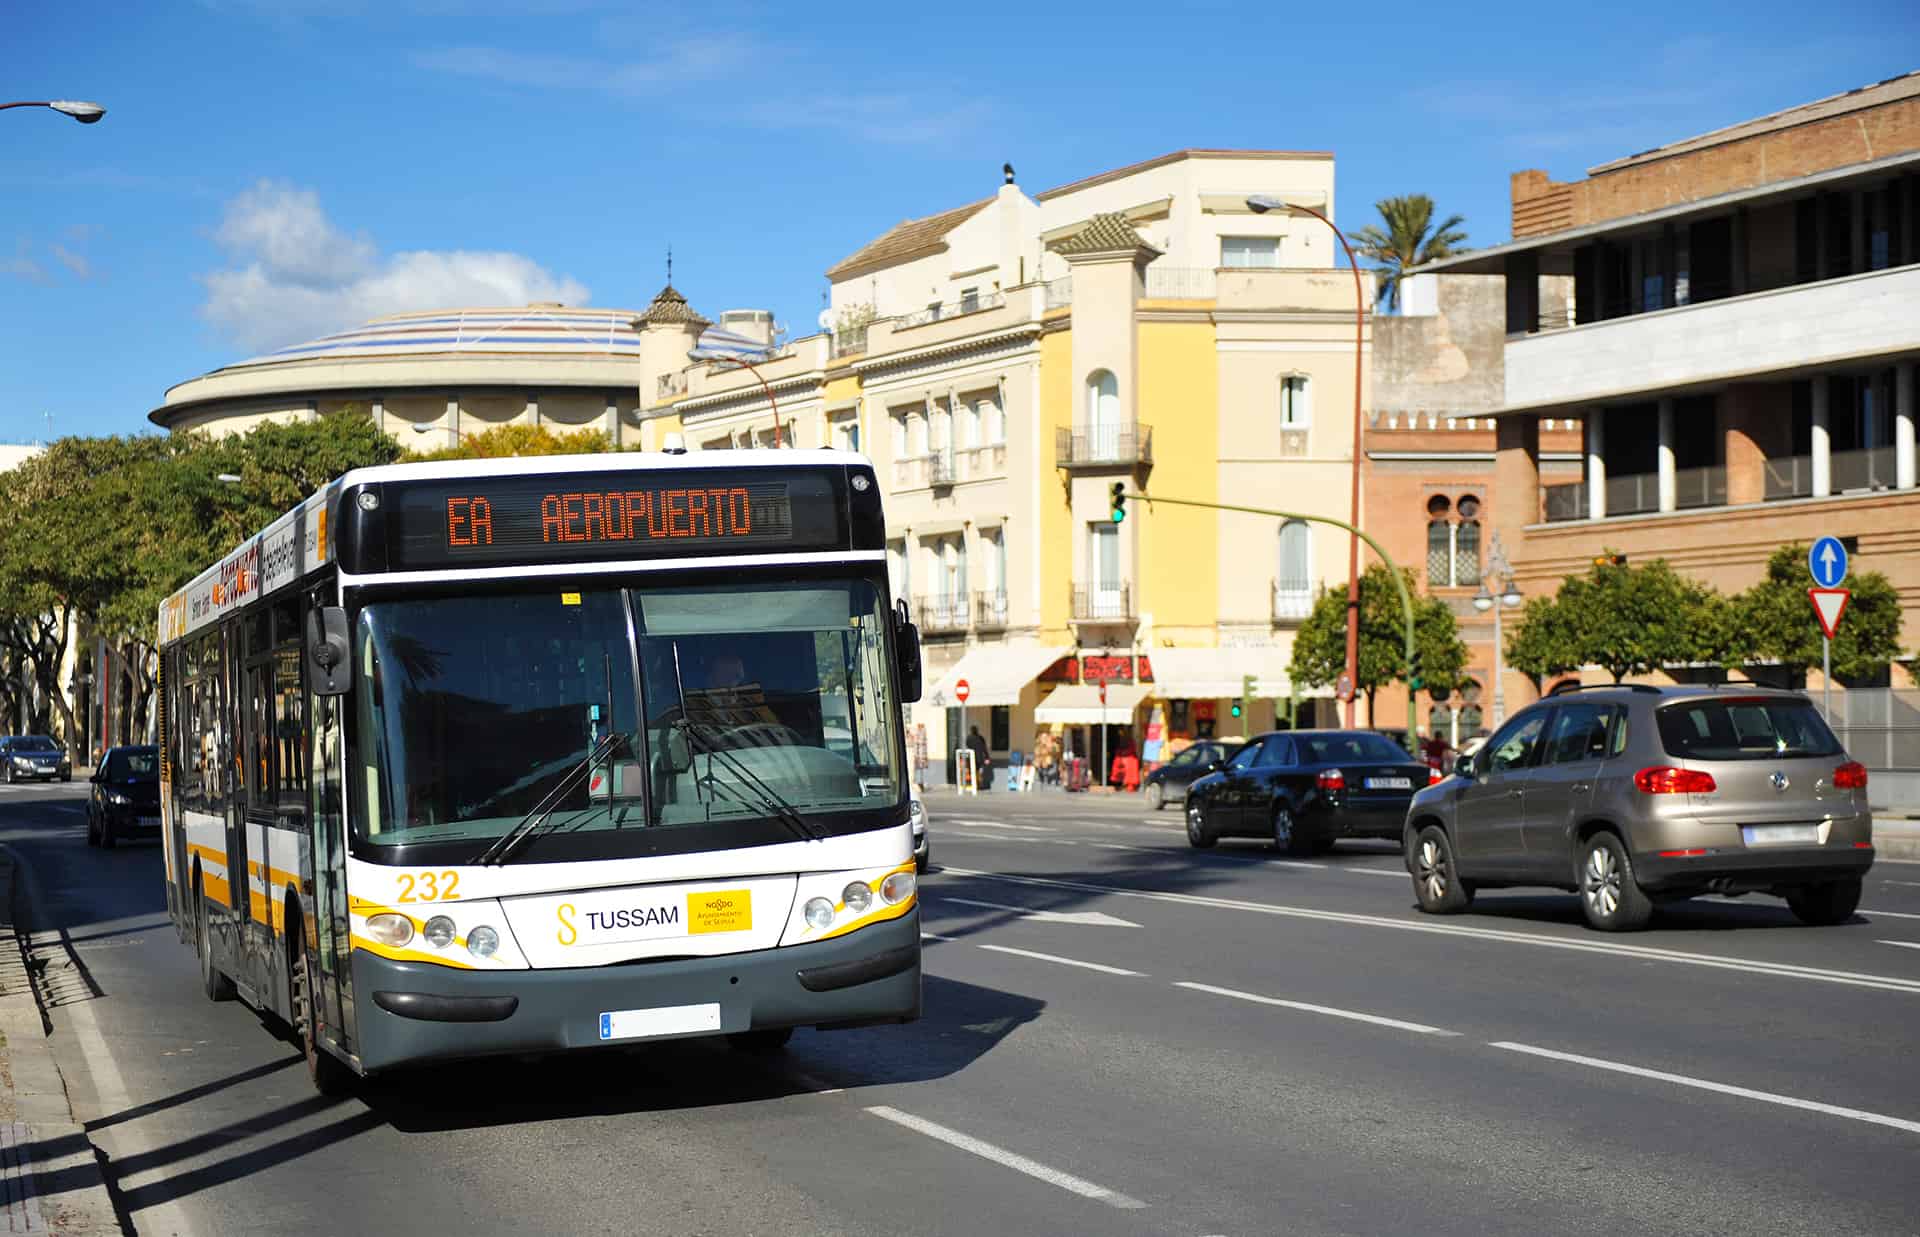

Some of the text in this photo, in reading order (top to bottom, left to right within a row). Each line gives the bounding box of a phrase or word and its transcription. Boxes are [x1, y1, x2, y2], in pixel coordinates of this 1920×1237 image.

[447, 487, 751, 545] EA AEROPUERTO
[397, 870, 461, 903] 232
[585, 905, 679, 930] TUSSAM
